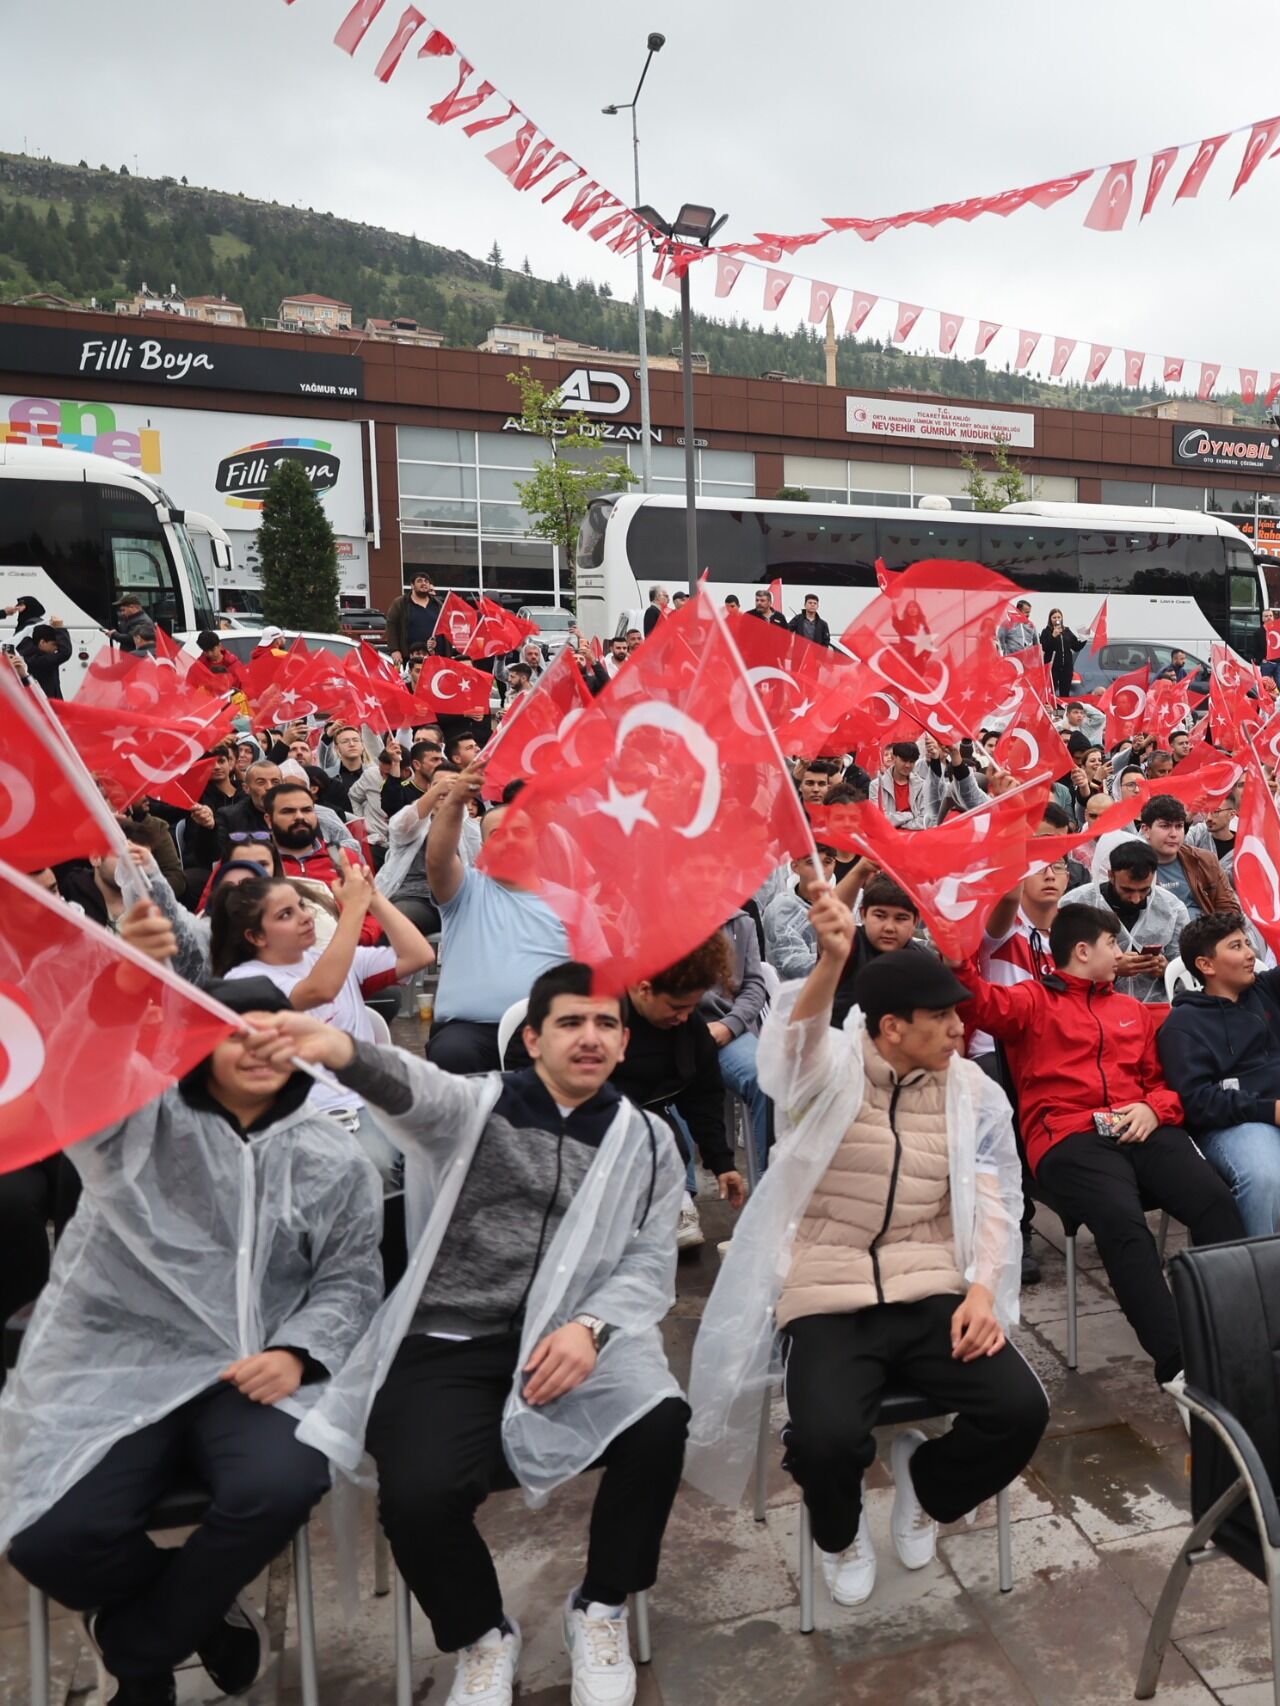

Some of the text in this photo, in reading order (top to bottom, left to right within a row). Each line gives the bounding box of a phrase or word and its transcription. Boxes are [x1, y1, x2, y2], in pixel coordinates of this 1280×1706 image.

[79, 338, 214, 380] Filli Boya
[300, 382, 357, 396] YAĞMUR YAPI
[872, 421, 915, 433] NEVŞEHİR
[226, 458, 269, 487] Filli
